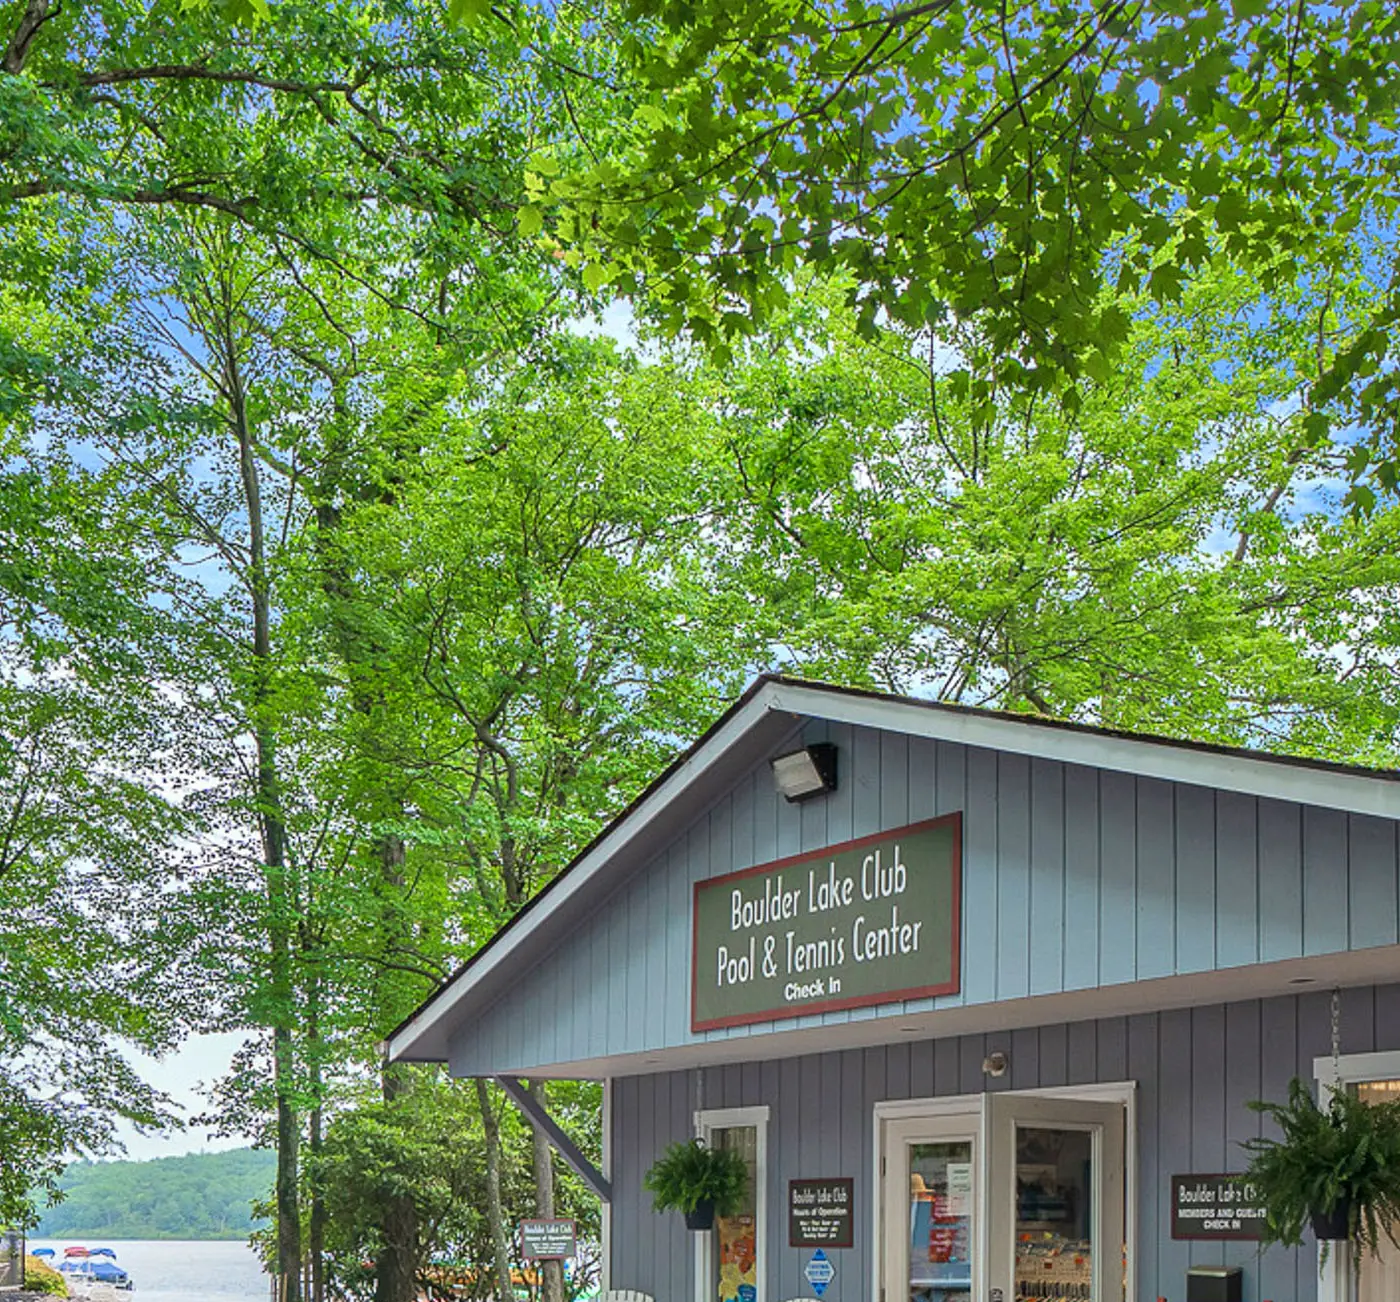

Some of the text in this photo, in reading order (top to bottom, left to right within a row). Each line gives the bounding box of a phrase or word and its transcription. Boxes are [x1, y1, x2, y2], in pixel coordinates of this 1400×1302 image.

[731, 845, 907, 931] Boulder Lake Club
[717, 905, 922, 986] Pool & Tennis Center
[784, 976, 841, 1001] Check In
[792, 1186, 848, 1204] Boulder Lake Club
[1179, 1183, 1216, 1202] Boulder
[1178, 1208, 1215, 1218] MEMBERS
[1216, 1208, 1234, 1218] AND
[1203, 1220, 1241, 1230] CHECK IN
